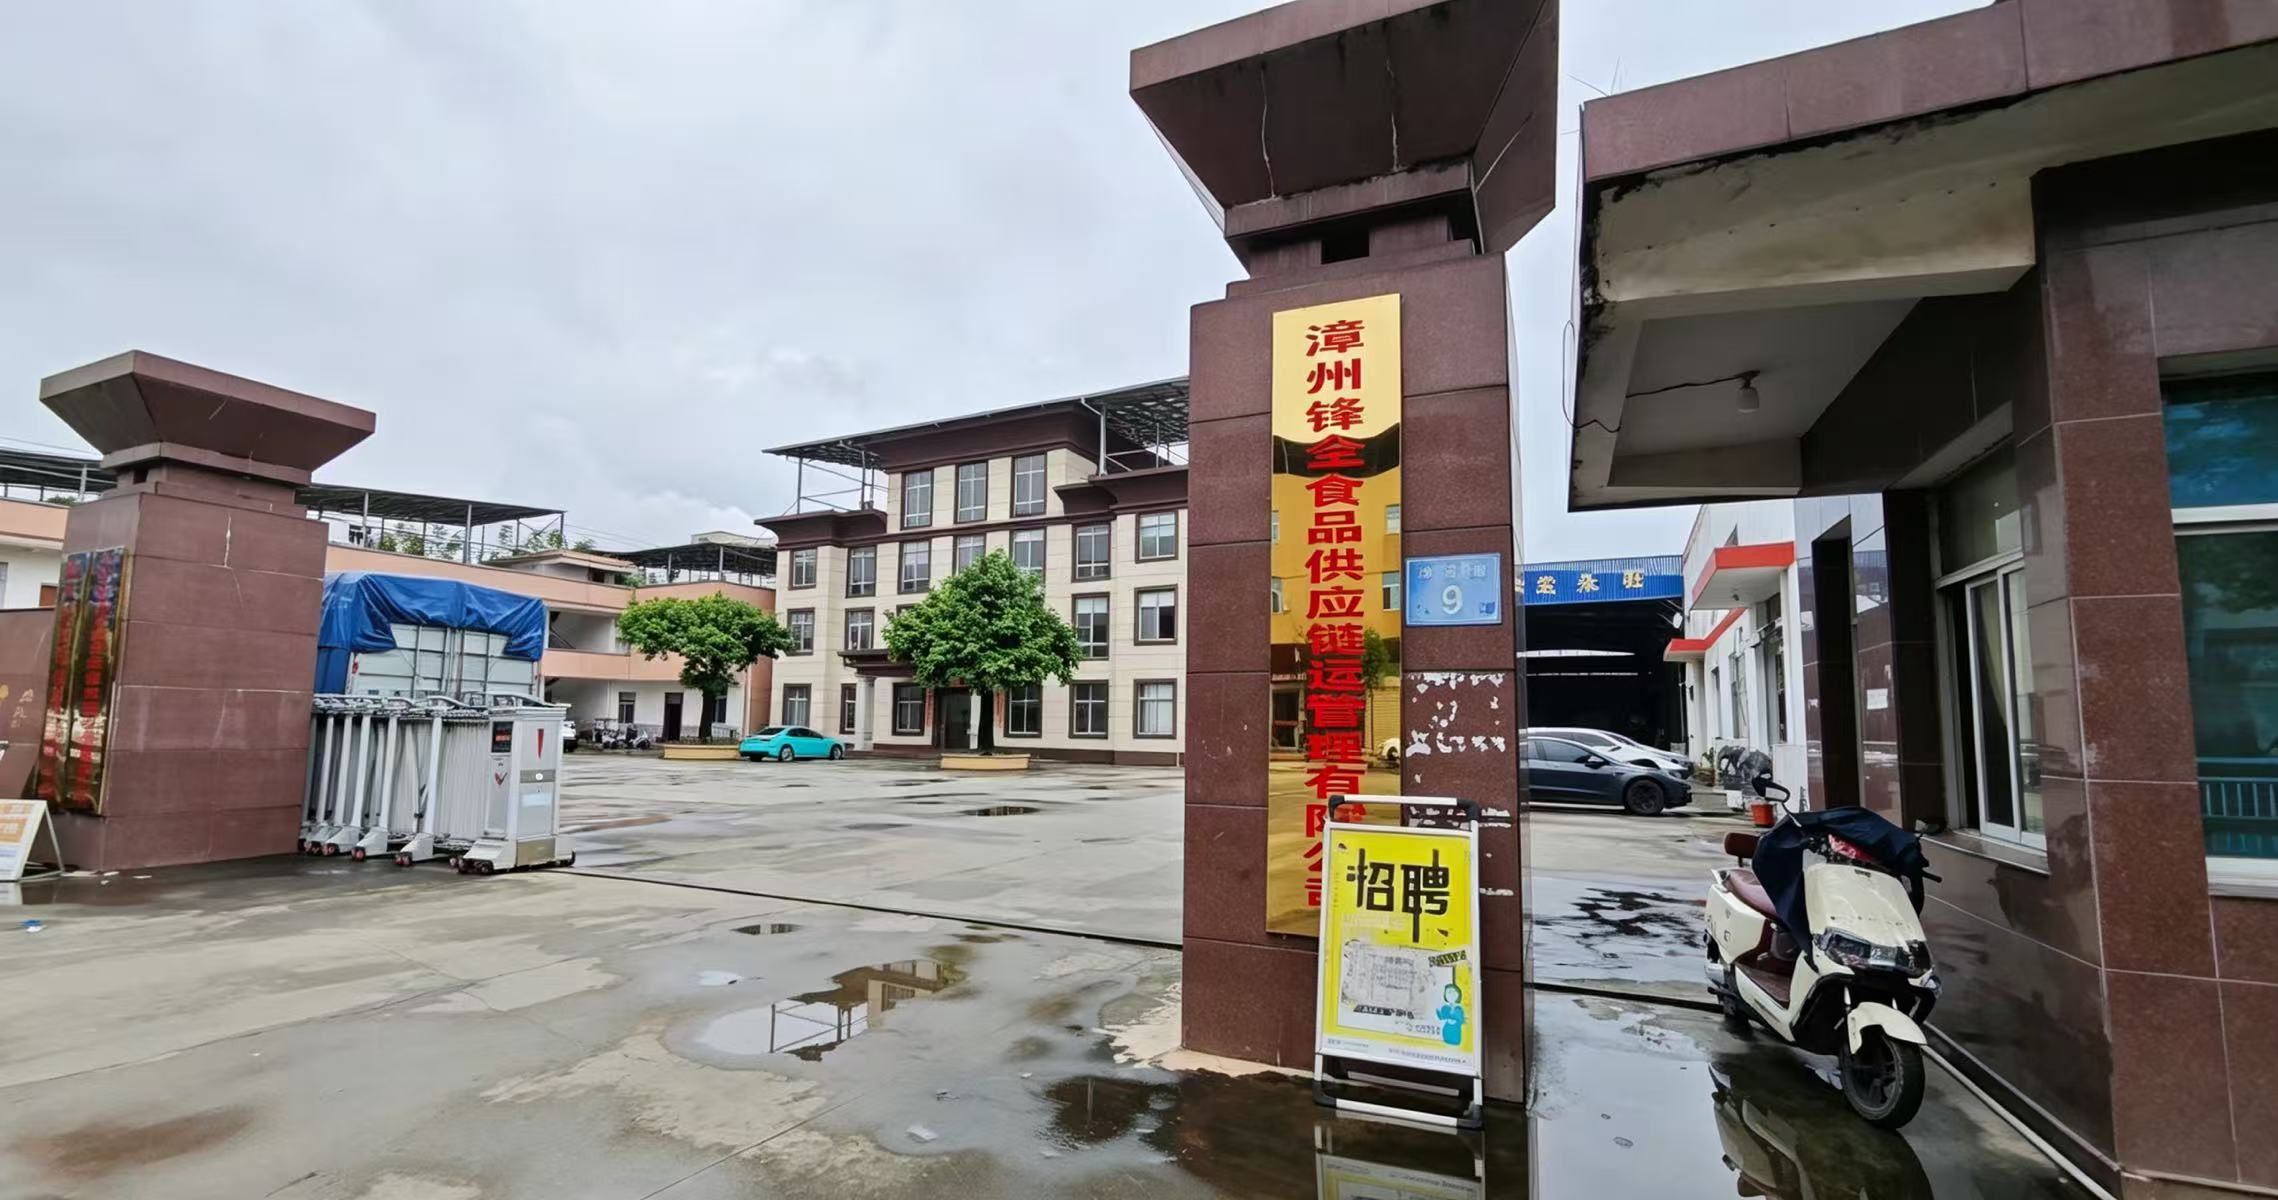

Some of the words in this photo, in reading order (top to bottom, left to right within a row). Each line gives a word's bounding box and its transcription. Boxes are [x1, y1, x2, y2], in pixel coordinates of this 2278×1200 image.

[1304, 320, 1366, 906] 漳州锋全食品供应链运管理有限
[1442, 584, 1463, 615] 9
[1346, 848, 1450, 943] 招聘
